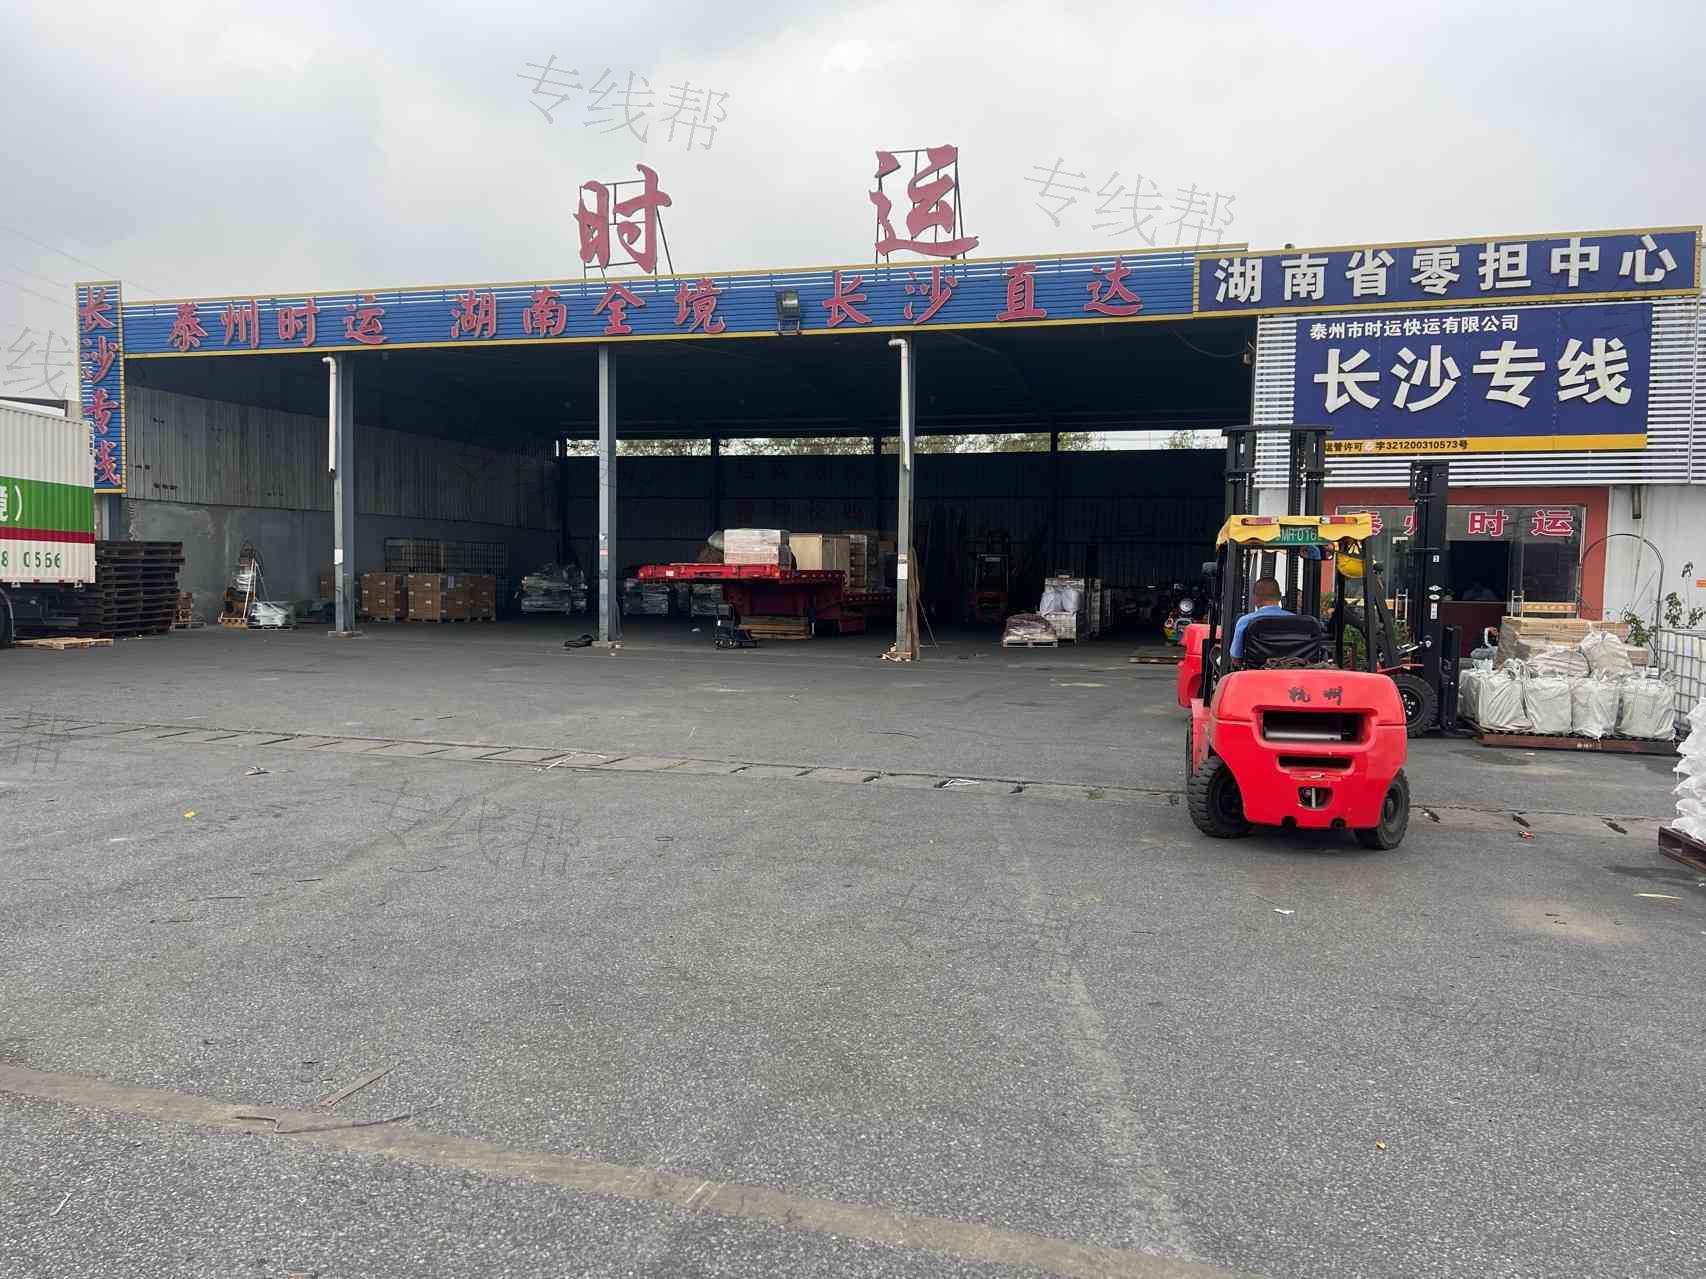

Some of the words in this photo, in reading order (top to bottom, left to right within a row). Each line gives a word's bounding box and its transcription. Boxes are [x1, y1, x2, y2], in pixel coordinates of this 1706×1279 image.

[167, 294, 390, 352] 泰州时运
[449, 277, 728, 340] 湖南全境
[821, 257, 1144, 328] 长沙直达
[1213, 233, 1679, 303] 湖南省零担中心
[1309, 313, 1520, 340] 泰州市时运快运有限公司
[1313, 336, 1633, 414] 长沙专线
